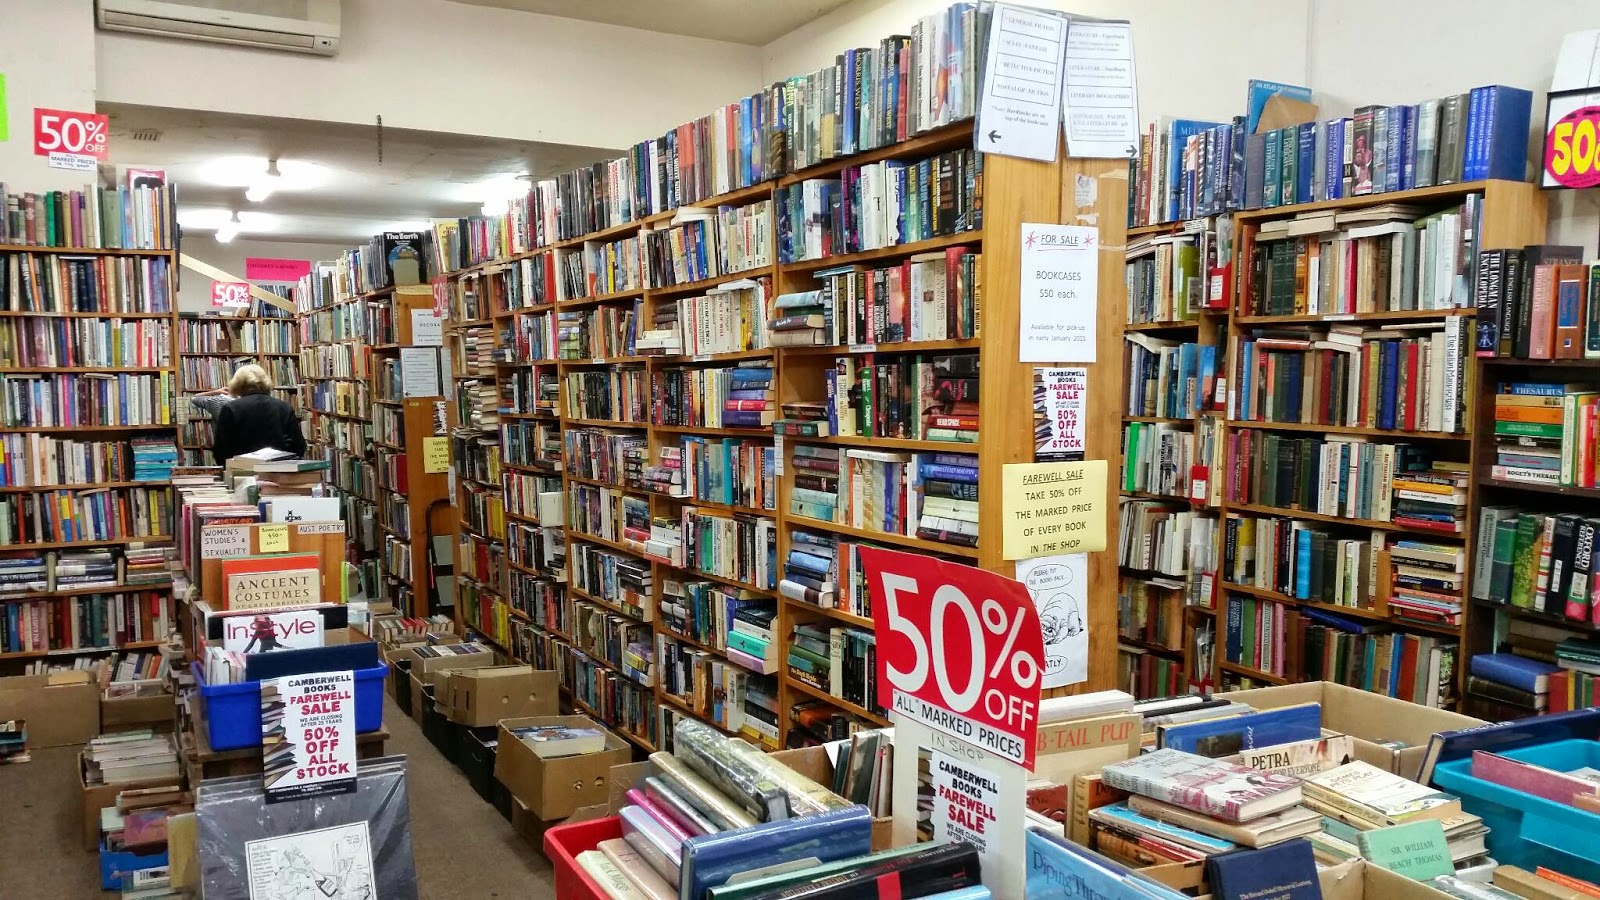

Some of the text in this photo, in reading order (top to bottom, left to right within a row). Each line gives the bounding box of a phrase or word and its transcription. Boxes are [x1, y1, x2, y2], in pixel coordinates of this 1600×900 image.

[39, 115, 106, 152] 50%
[85, 144, 105, 152] OFF
[919, 160, 928, 202] LUDLUM
[1041, 235, 1079, 244] FOR SALE
[1036, 271, 1081, 281] BOOKCASES
[1478, 253, 1489, 308] ENCYCLOPEDIA
[1488, 253, 1500, 308] THE LONGMAN
[215, 285, 248, 303] 50%
[1040, 289, 1077, 299] $50 each.
[1504, 303, 1512, 332] LANGUAGE
[1444, 334, 1456, 411] The Italian Manuscripts
[1056, 391, 1078, 399] SALE
[1516, 387, 1563, 395] THESAURUS
[1058, 410, 1077, 419] 50%
[1058, 420, 1077, 429] OFF
[1060, 430, 1075, 438] ALL
[1053, 440, 1081, 448] STOCK
[1023, 470, 1083, 483] FAREWELL SALE
[1025, 487, 1081, 500] TAKE 50% OFF
[1015, 503, 1092, 519] THE MARKED PRICE
[319, 524, 344, 532] POETRY
[1024, 521, 1086, 536] OF EVERY BOOK
[205, 548, 246, 556] SEXUALITY
[1031, 540, 1080, 553] IN THE SHOP
[1574, 525, 1586, 565] REFERENCE
[1581, 526, 1594, 568] OXFORD
[236, 576, 309, 590] ANCIENT
[235, 589, 309, 602] COSTUMES
[227, 619, 316, 639] InStyle
[880, 571, 1038, 713] 50%
[1045, 659, 1063, 668] ATLY.
[288, 675, 351, 687] CAMBERWELL
[304, 684, 336, 694] BOOKS
[290, 690, 351, 705] FAREWELL
[301, 701, 341, 715] SALE
[984, 688, 1034, 732] OFF
[304, 726, 339, 741] 50%
[921, 704, 972, 737] MARKED
[979, 727, 1022, 758] PRICES
[1037, 721, 1134, 751] B-TAIL PUP
[305, 739, 339, 754] OFF
[932, 732, 984, 761] IN SHOP
[309, 753, 337, 765] ALL
[1252, 752, 1291, 770] PETRA
[296, 763, 350, 779] STOCK
[1288, 762, 1321, 777] EVERYONE
[939, 761, 998, 794] CAMBERWELL
[952, 778, 982, 799] BOOKS
[939, 784, 996, 822] FAREWELL
[948, 804, 985, 834] SALE
[946, 822, 986, 846] WE ARE CLOSING
[947, 830, 962, 842] AFTER
[1391, 840, 1434, 855] SIR WILLIAM
[1388, 854, 1443, 870] BEACH THOMAS
[1033, 850, 1072, 897] Piping
